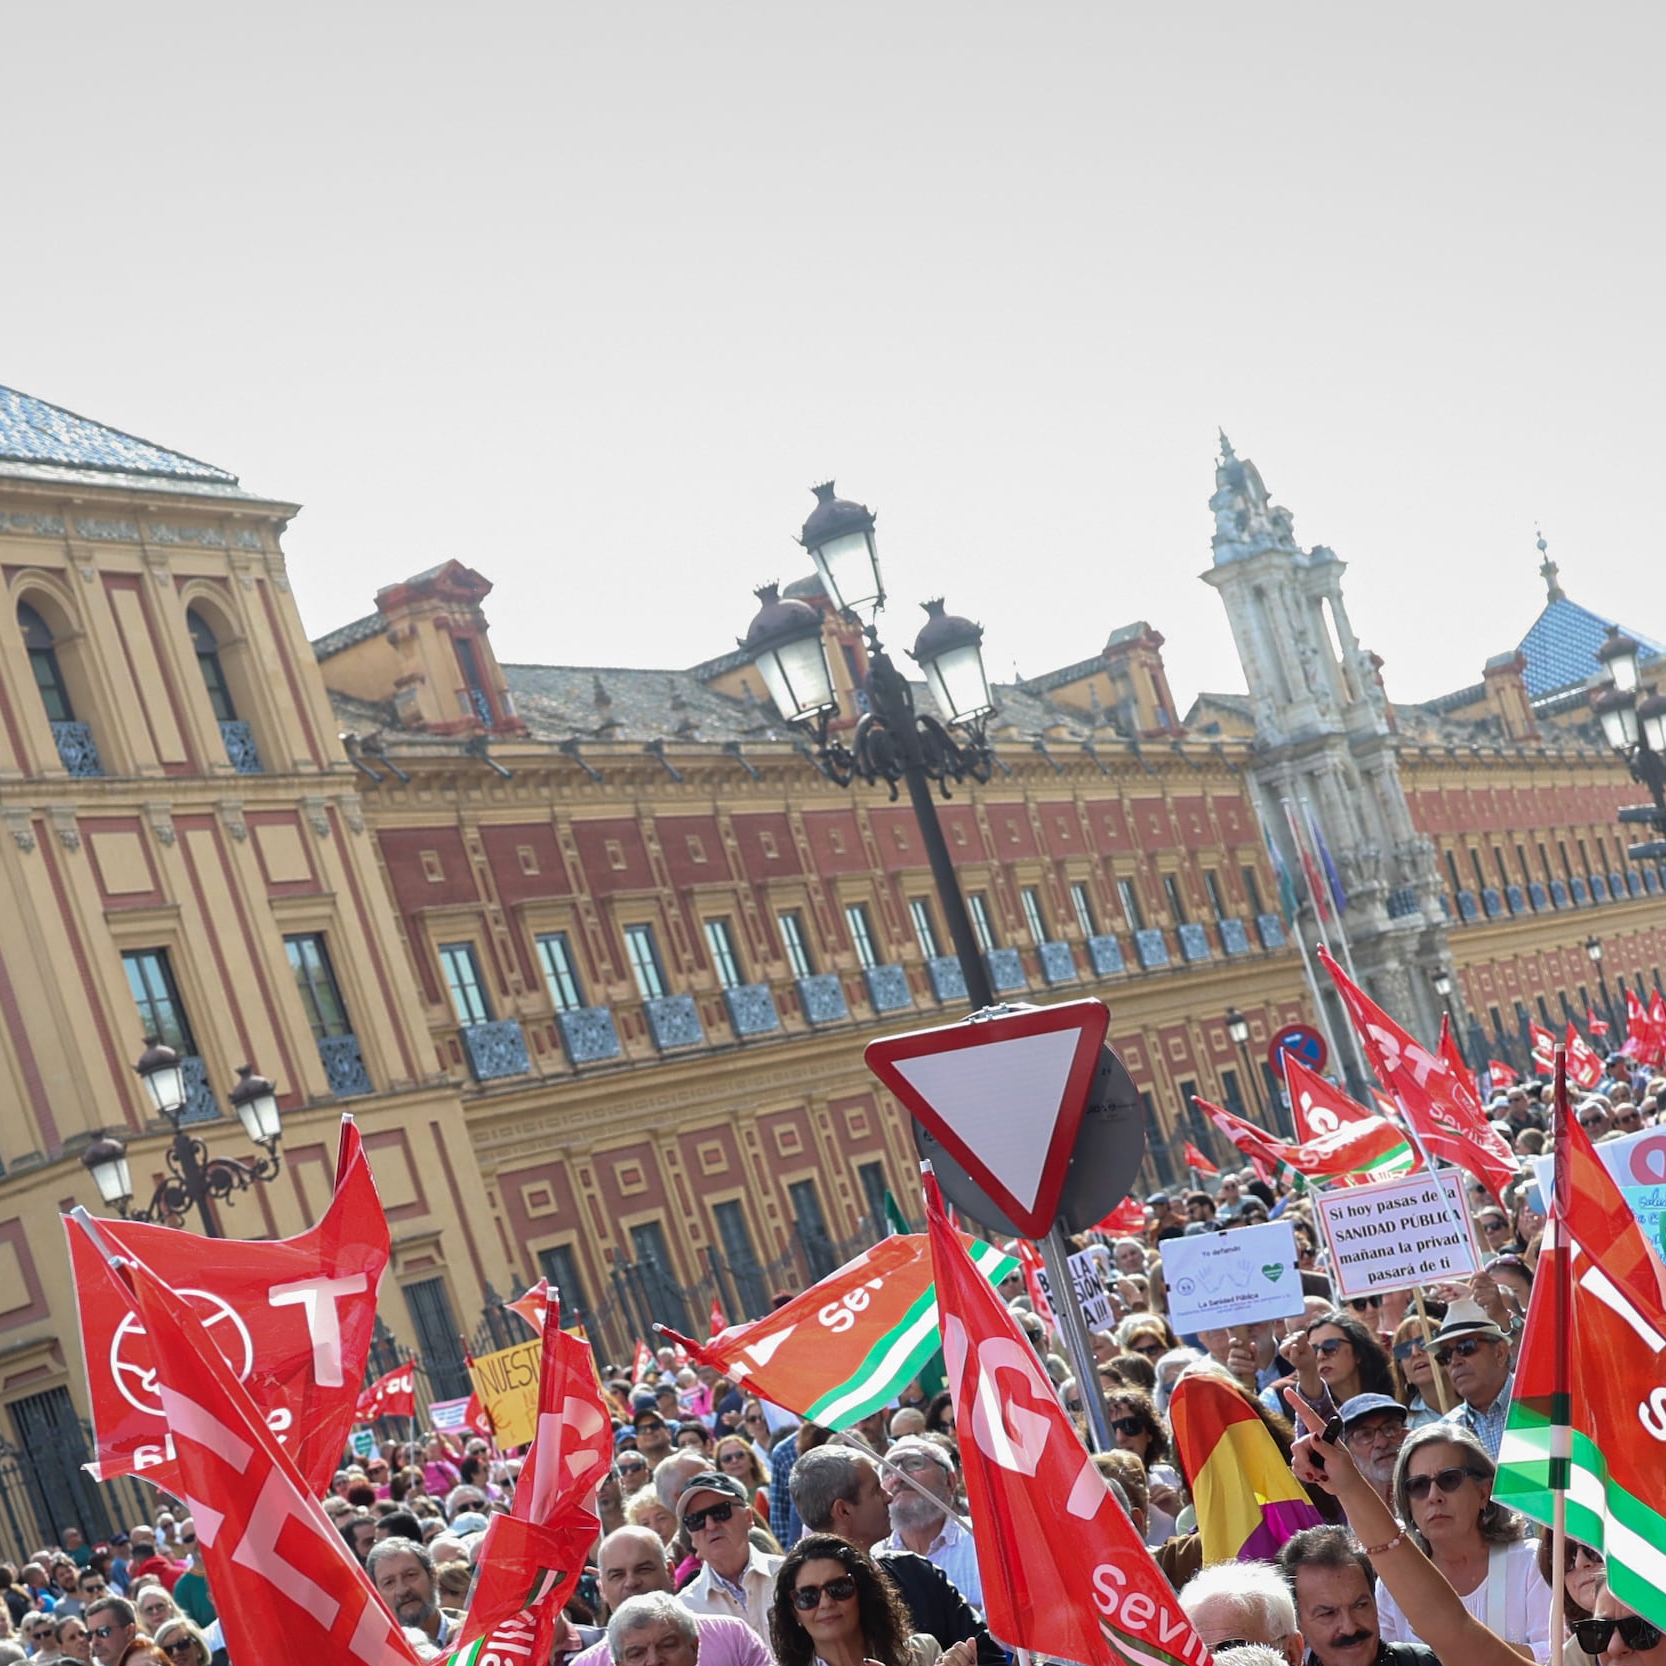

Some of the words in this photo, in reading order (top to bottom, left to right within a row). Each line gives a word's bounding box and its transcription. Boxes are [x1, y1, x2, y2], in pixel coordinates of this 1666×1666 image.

[1330, 1206, 1344, 1221] Si
[1347, 1202, 1372, 1218] hoy
[1376, 1195, 1418, 1214] pasas
[1421, 1190, 1438, 1204] de
[1335, 1220, 1396, 1243] SANIDAD
[1400, 1207, 1462, 1231] PÚBLICA
[1339, 1244, 1395, 1265] mañana
[1398, 1241, 1413, 1254] la
[1416, 1231, 1469, 1253] privada
[1368, 1263, 1416, 1285] pasará
[1419, 1260, 1437, 1273] de
[1440, 1256, 1451, 1269] ti
